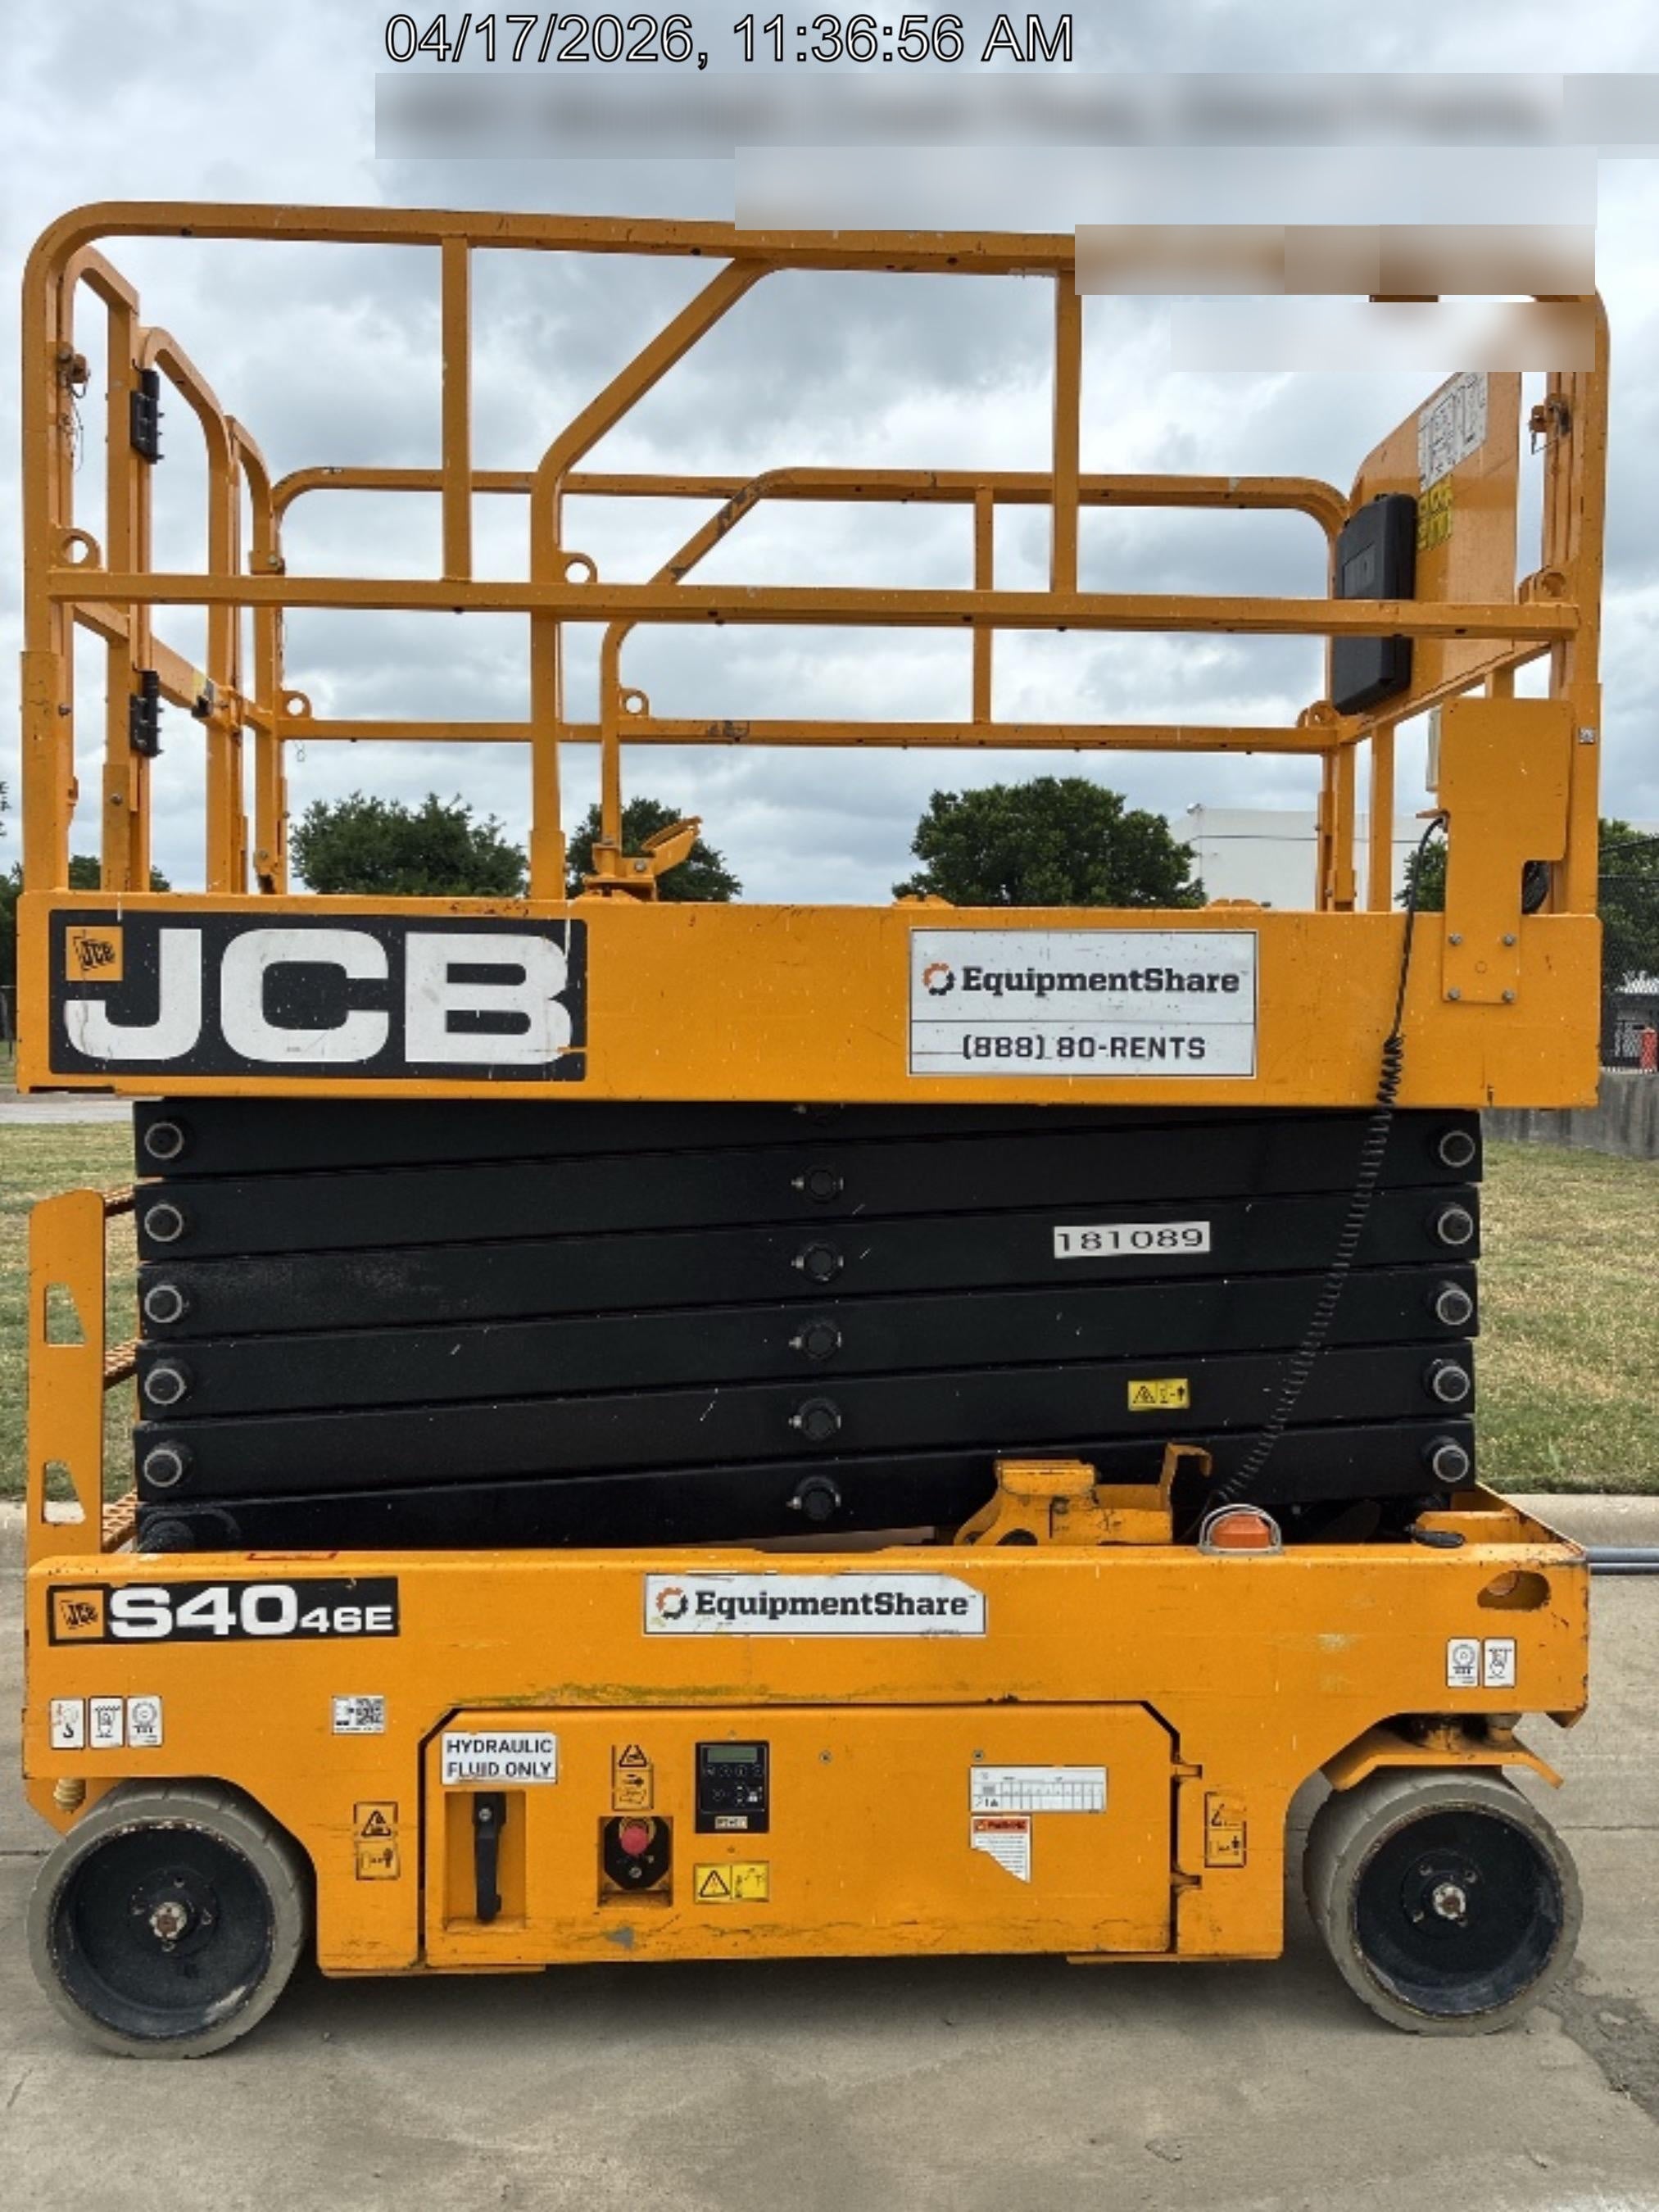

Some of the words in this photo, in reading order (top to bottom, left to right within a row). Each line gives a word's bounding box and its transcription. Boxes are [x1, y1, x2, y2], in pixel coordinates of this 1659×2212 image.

[78, 939, 116, 968] JCB
[961, 966, 1240, 996] EquipmentShare
[65, 928, 572, 1064] JCB
[963, 1035, 1045, 1059] (888)
[1057, 1036, 1205, 1059] 80-RENTS
[1057, 1229, 1203, 1251] 181089
[695, 1590, 968, 1620] EquipmentShare
[446, 1739, 553, 1753] HYDRAULIC
[447, 1761, 500, 1777] FLUID
[505, 1761, 551, 1777] ONLY
